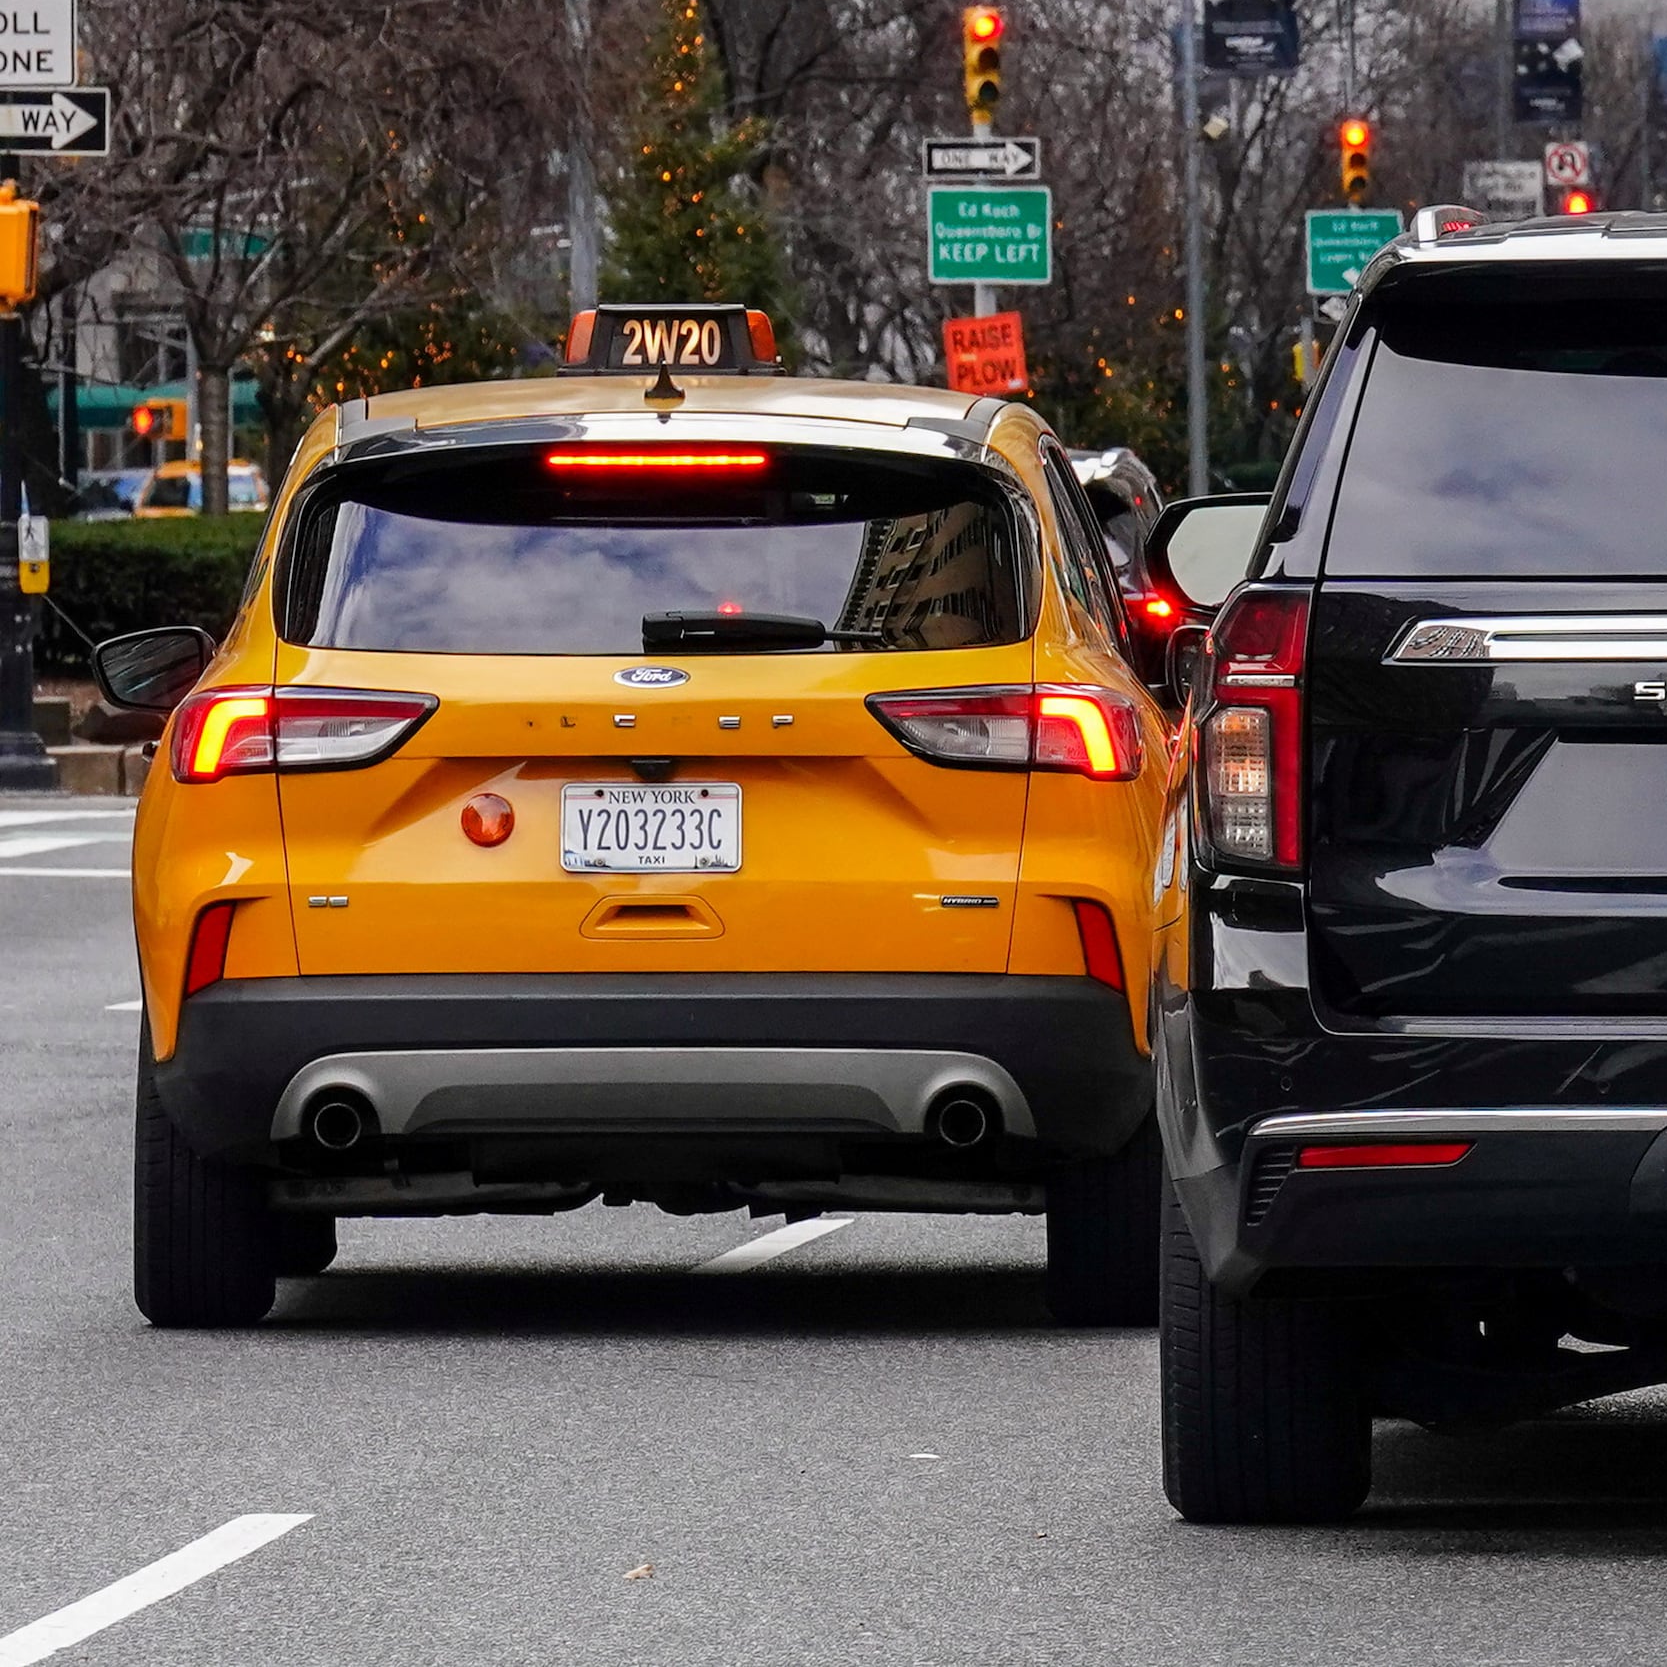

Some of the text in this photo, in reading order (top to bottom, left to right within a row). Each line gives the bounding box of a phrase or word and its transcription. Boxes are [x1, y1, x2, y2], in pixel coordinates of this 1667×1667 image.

[22, 110, 77, 133] WAY
[941, 149, 1021, 167] ONE WAY
[938, 243, 1040, 263] KEEP LEFT
[623, 319, 721, 365] 2W20
[952, 323, 1012, 352] RAISE
[956, 359, 1017, 385] PLOW
[631, 668, 672, 681] Ford
[608, 790, 696, 804] NEW YORK
[578, 809, 722, 851] Y203233C
[638, 856, 665, 864] TAXI
